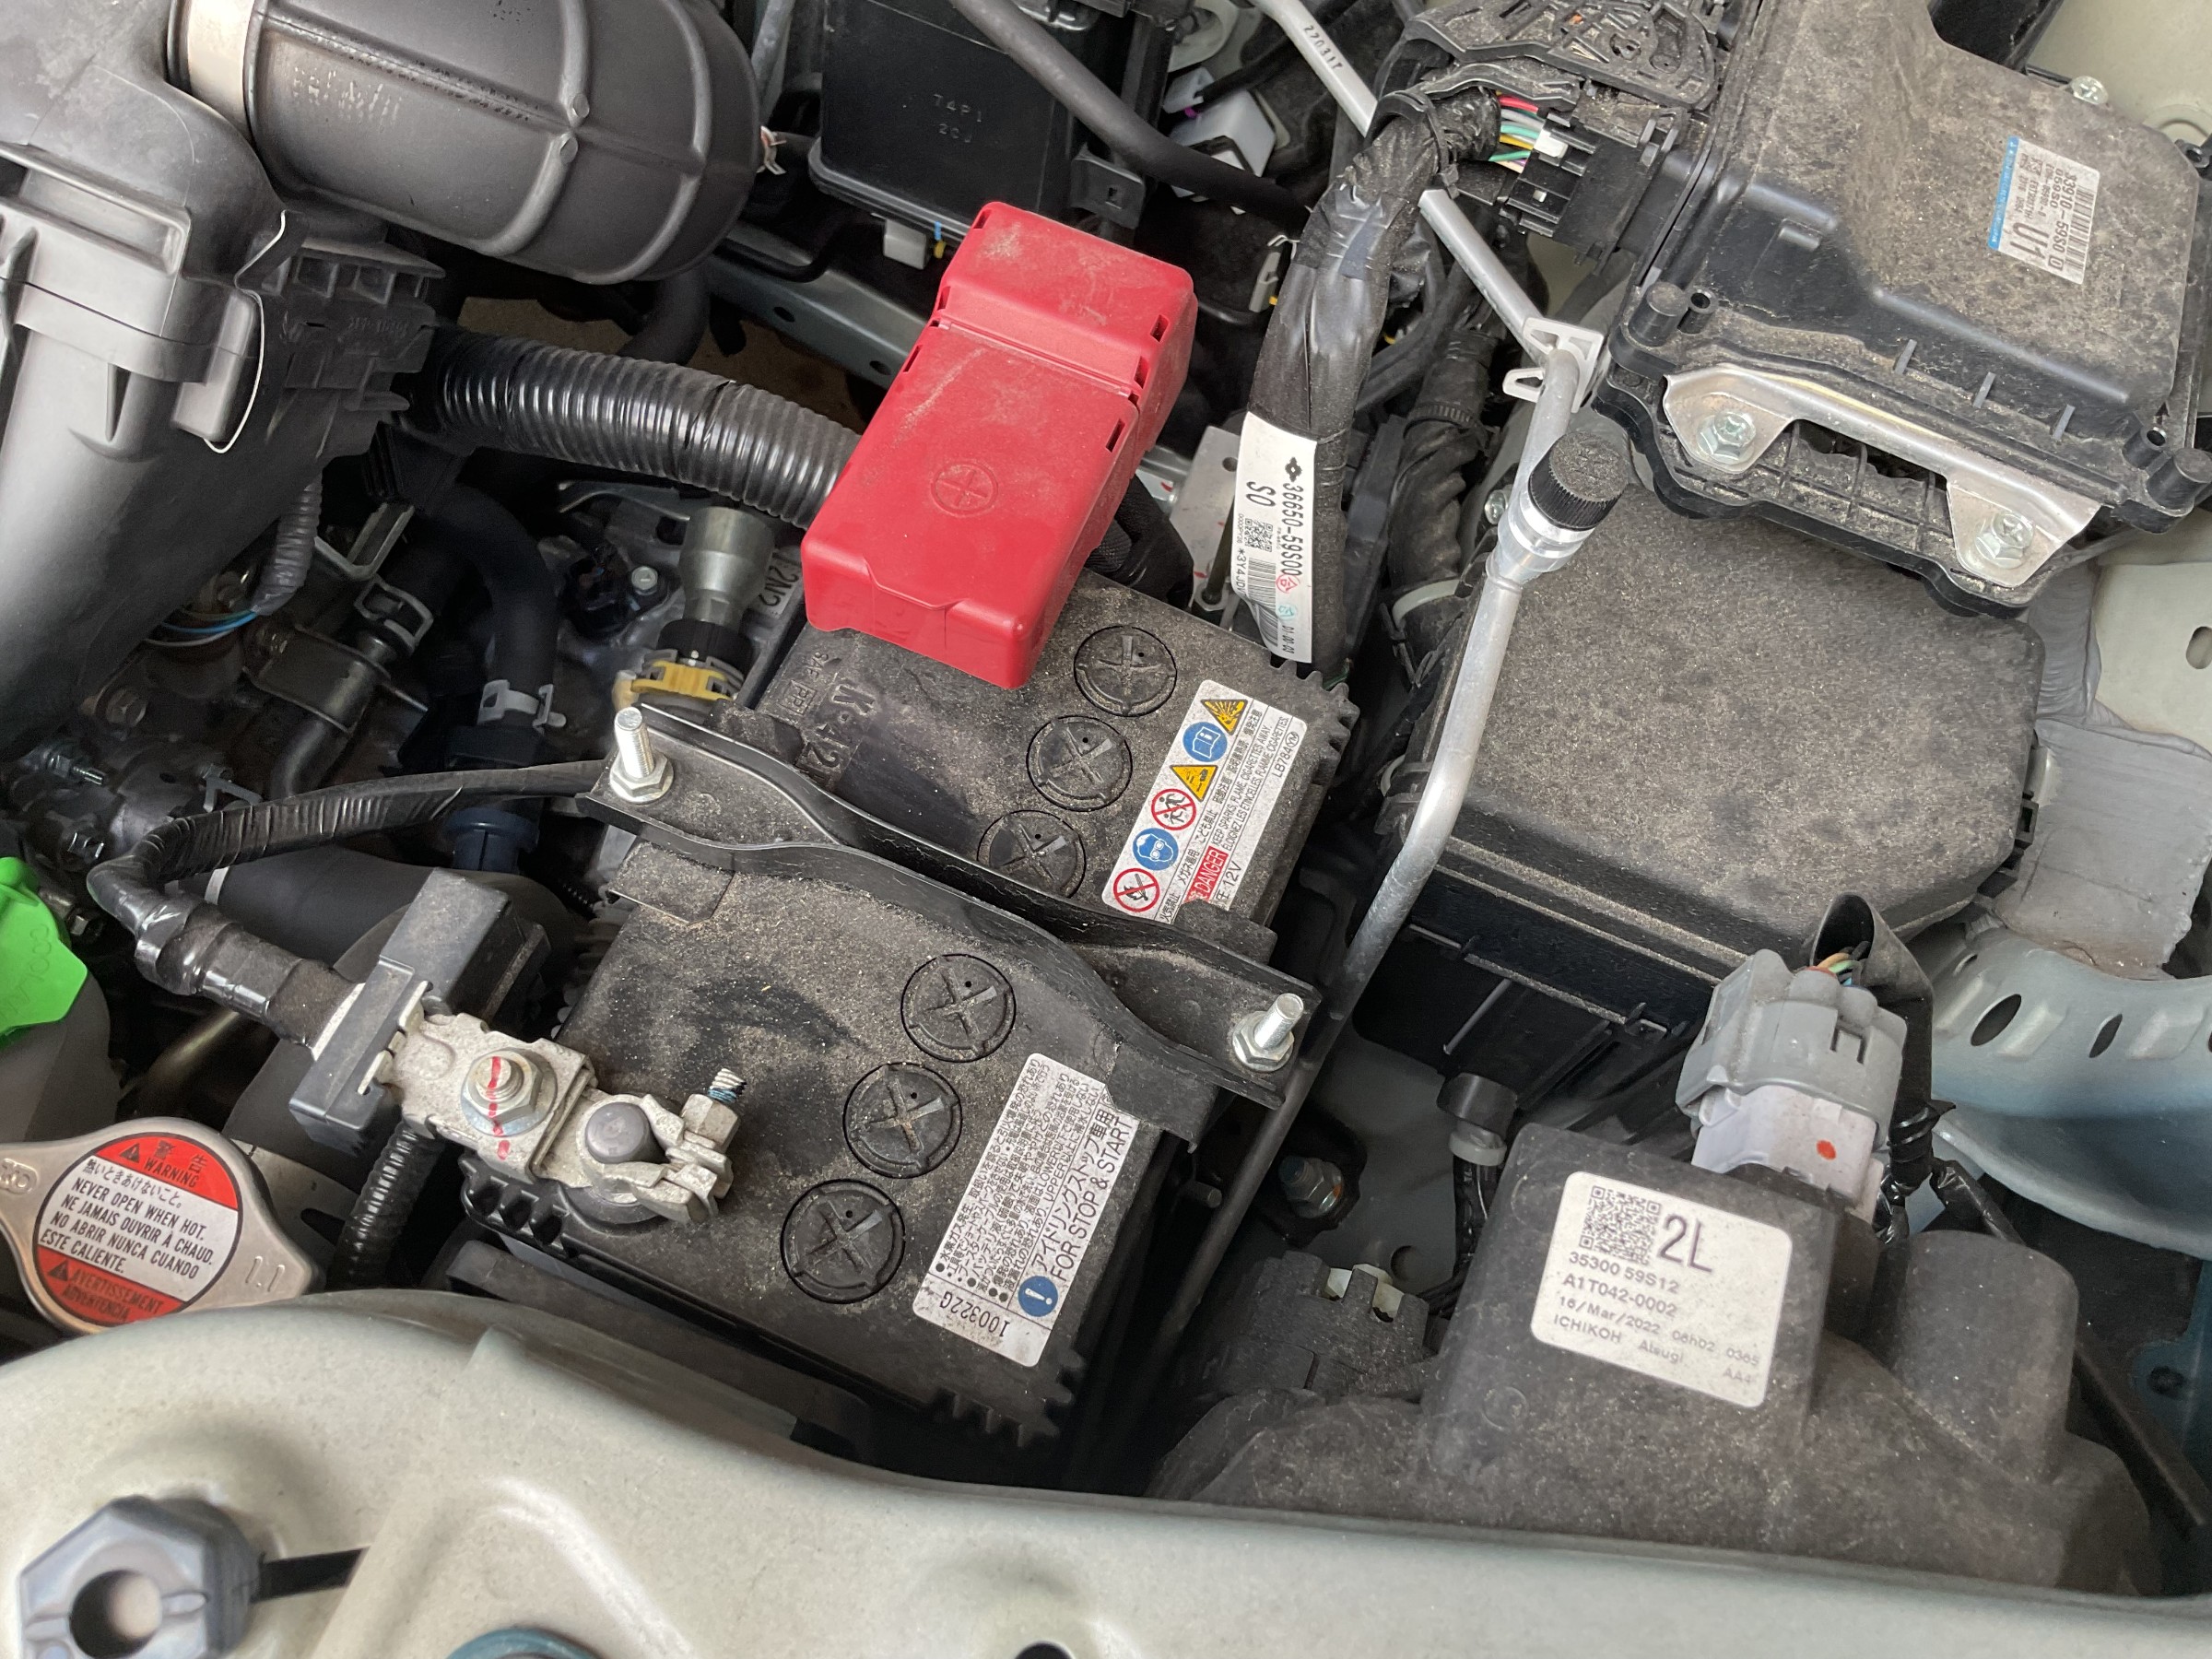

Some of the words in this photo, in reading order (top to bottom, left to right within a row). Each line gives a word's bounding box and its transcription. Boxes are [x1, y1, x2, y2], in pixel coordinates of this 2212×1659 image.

[2008, 222, 2050, 260] U1
[1280, 482, 1303, 575] 36650-59S00
[1271, 745, 1293, 778] LB784
[1210, 825, 1226, 846] KEEP
[1240, 742, 1264, 781] CIGARETTES
[1234, 808, 1246, 822] LES
[1194, 847, 1226, 893] DANGER
[1221, 860, 1242, 888] 12V
[1095, 1116, 1134, 1175] START
[143, 1156, 199, 1189] WARNING
[1030, 1107, 1115, 1273] アイドリングストップ車用
[1089, 1171, 1109, 1190] &
[61, 1193, 79, 1212] NE
[77, 1198, 120, 1228] JAMAIS
[120, 1215, 161, 1243] OUVRIR
[161, 1229, 174, 1247] À
[173, 1236, 217, 1265] CHAUD.
[71, 1175, 110, 1203] NEVER
[110, 1191, 142, 1215] OPEN
[144, 1204, 179, 1230] WHEN
[179, 1218, 208, 1241] HOT.
[1067, 1189, 1103, 1241] STOP
[40, 1227, 70, 1251] ESTE
[70, 1238, 128, 1274] CALIENTE.
[50, 1209, 69, 1229] NO
[69, 1217, 106, 1243] ABRIR
[107, 1231, 148, 1260] NUNCA
[149, 1248, 200, 1280] CUANDO
[1049, 1238, 1080, 1282] FOR
[1657, 1214, 1712, 1273] 2L
[1562, 1272, 1677, 1318] A1T042-0002
[1568, 1250, 1621, 1277] 35300
[1622, 1266, 1681, 1294] 59S12
[938, 1290, 1010, 1337] 100322G
[1553, 1313, 1623, 1344] ICHIKOH
